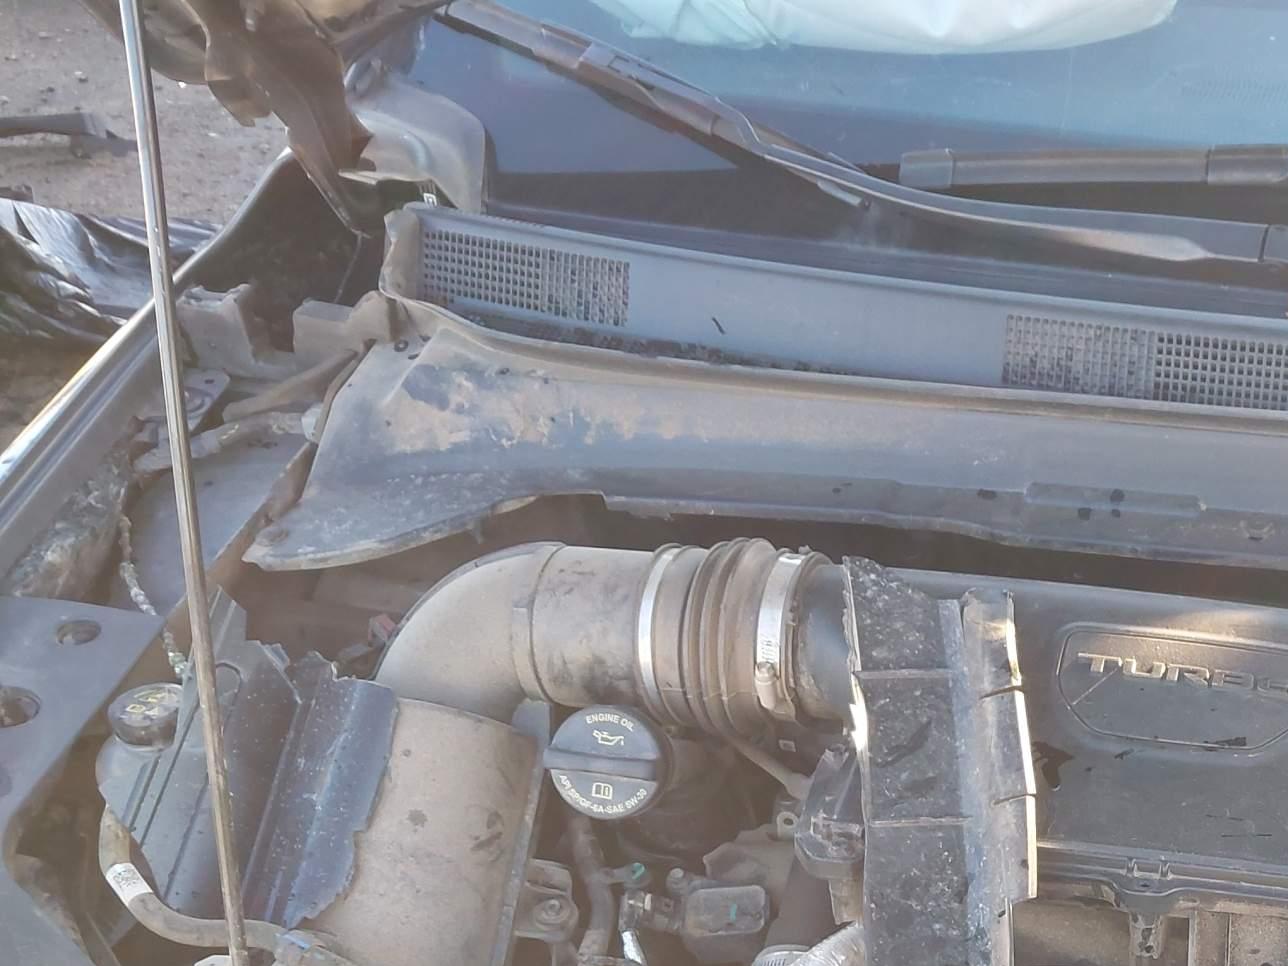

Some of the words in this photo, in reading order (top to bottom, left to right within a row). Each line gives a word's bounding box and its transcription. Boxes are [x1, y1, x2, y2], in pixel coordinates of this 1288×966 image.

[586, 713, 620, 724] ENGINE
[620, 718, 634, 732] OIL
[559, 775, 572, 789] API
